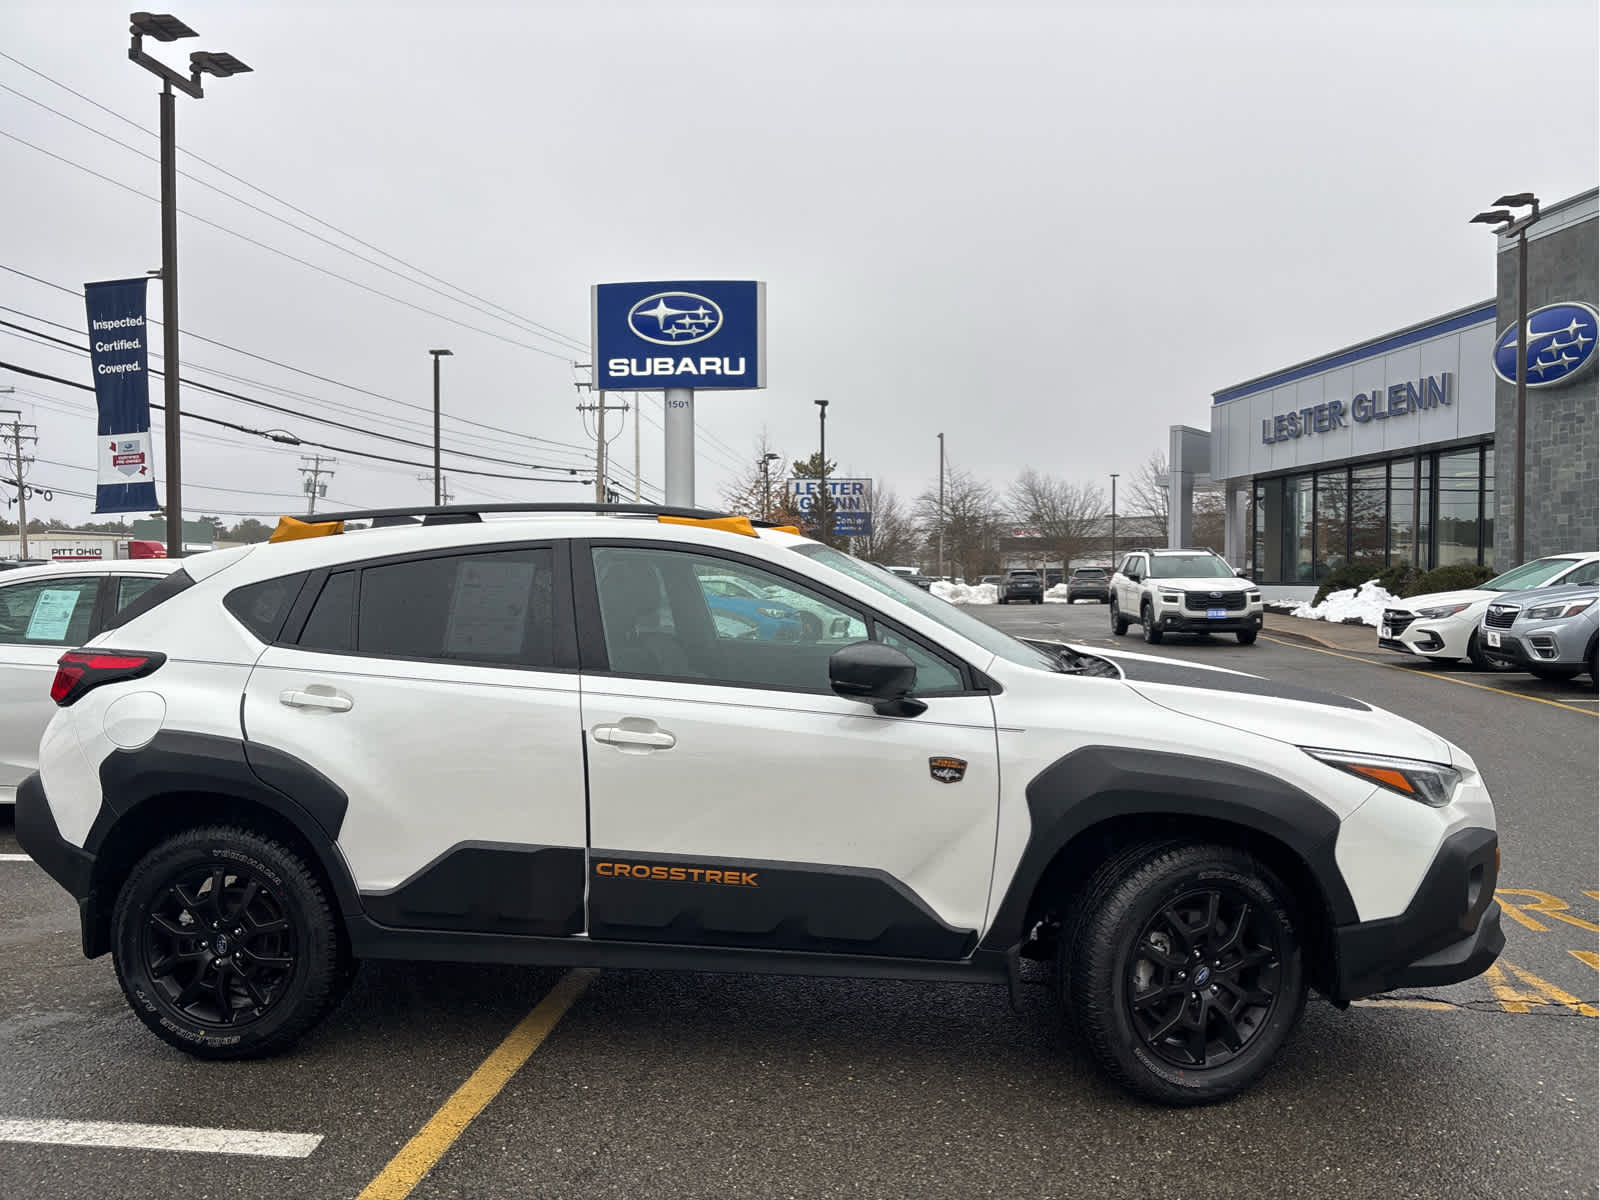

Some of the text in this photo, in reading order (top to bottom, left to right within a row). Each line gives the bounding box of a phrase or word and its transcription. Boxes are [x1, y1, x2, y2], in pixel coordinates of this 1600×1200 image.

[93, 315, 145, 331] Inspected.
[95, 338, 141, 352] Certified.
[98, 361, 141, 374] Covered.
[608, 357, 746, 377] SUBARU
[668, 400, 690, 409] 1501
[1262, 372, 1451, 445] LESTER GLENN
[799, 496, 861, 510] GNN
[51, 548, 103, 556] PITT OHIO
[595, 863, 759, 886] CROSSTREK
